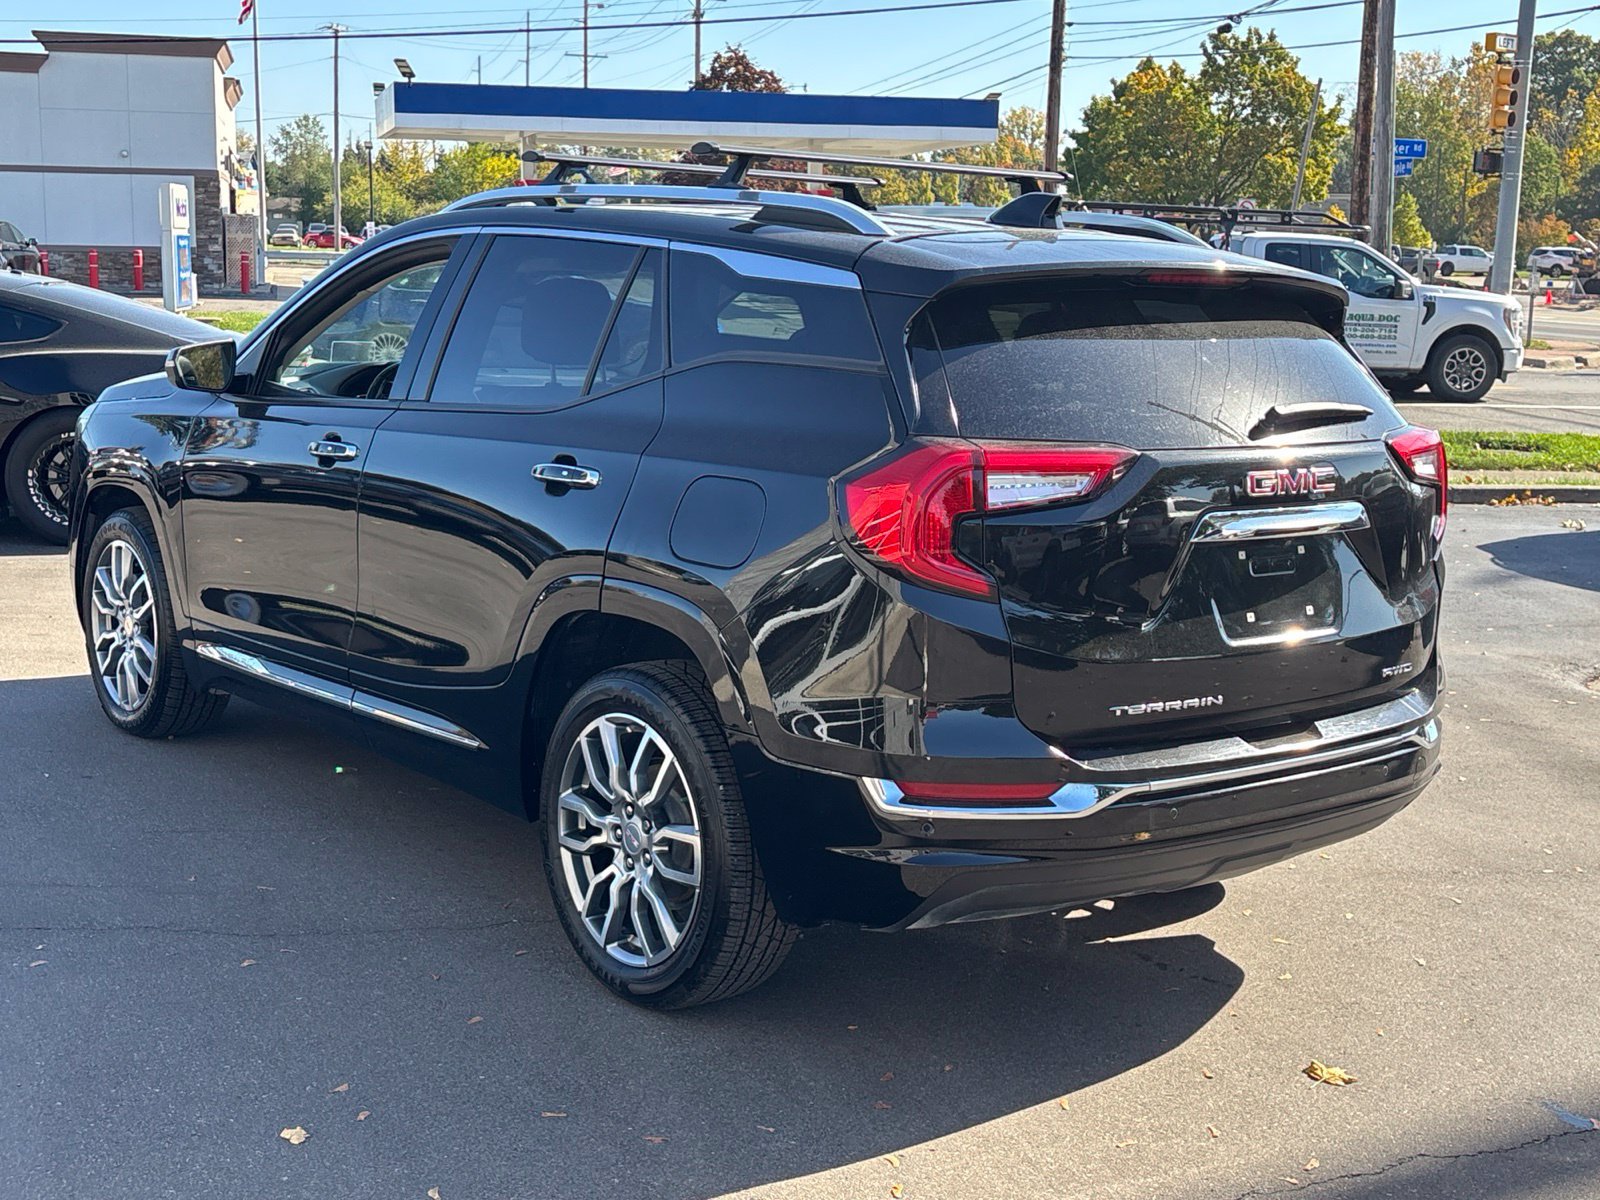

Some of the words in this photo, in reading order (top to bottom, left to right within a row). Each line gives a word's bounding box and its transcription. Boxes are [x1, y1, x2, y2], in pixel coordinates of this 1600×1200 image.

[1499, 37, 1514, 48] LEFT
[1394, 143, 1410, 155] ker
[1414, 143, 1423, 152] Rd
[1395, 162, 1406, 176] ple
[1346, 313, 1375, 322] AQUA
[1378, 314, 1401, 323] DOC
[1247, 467, 1336, 497] GMC
[1382, 662, 1413, 678] AWD
[1109, 695, 1224, 716] TERRAIN
